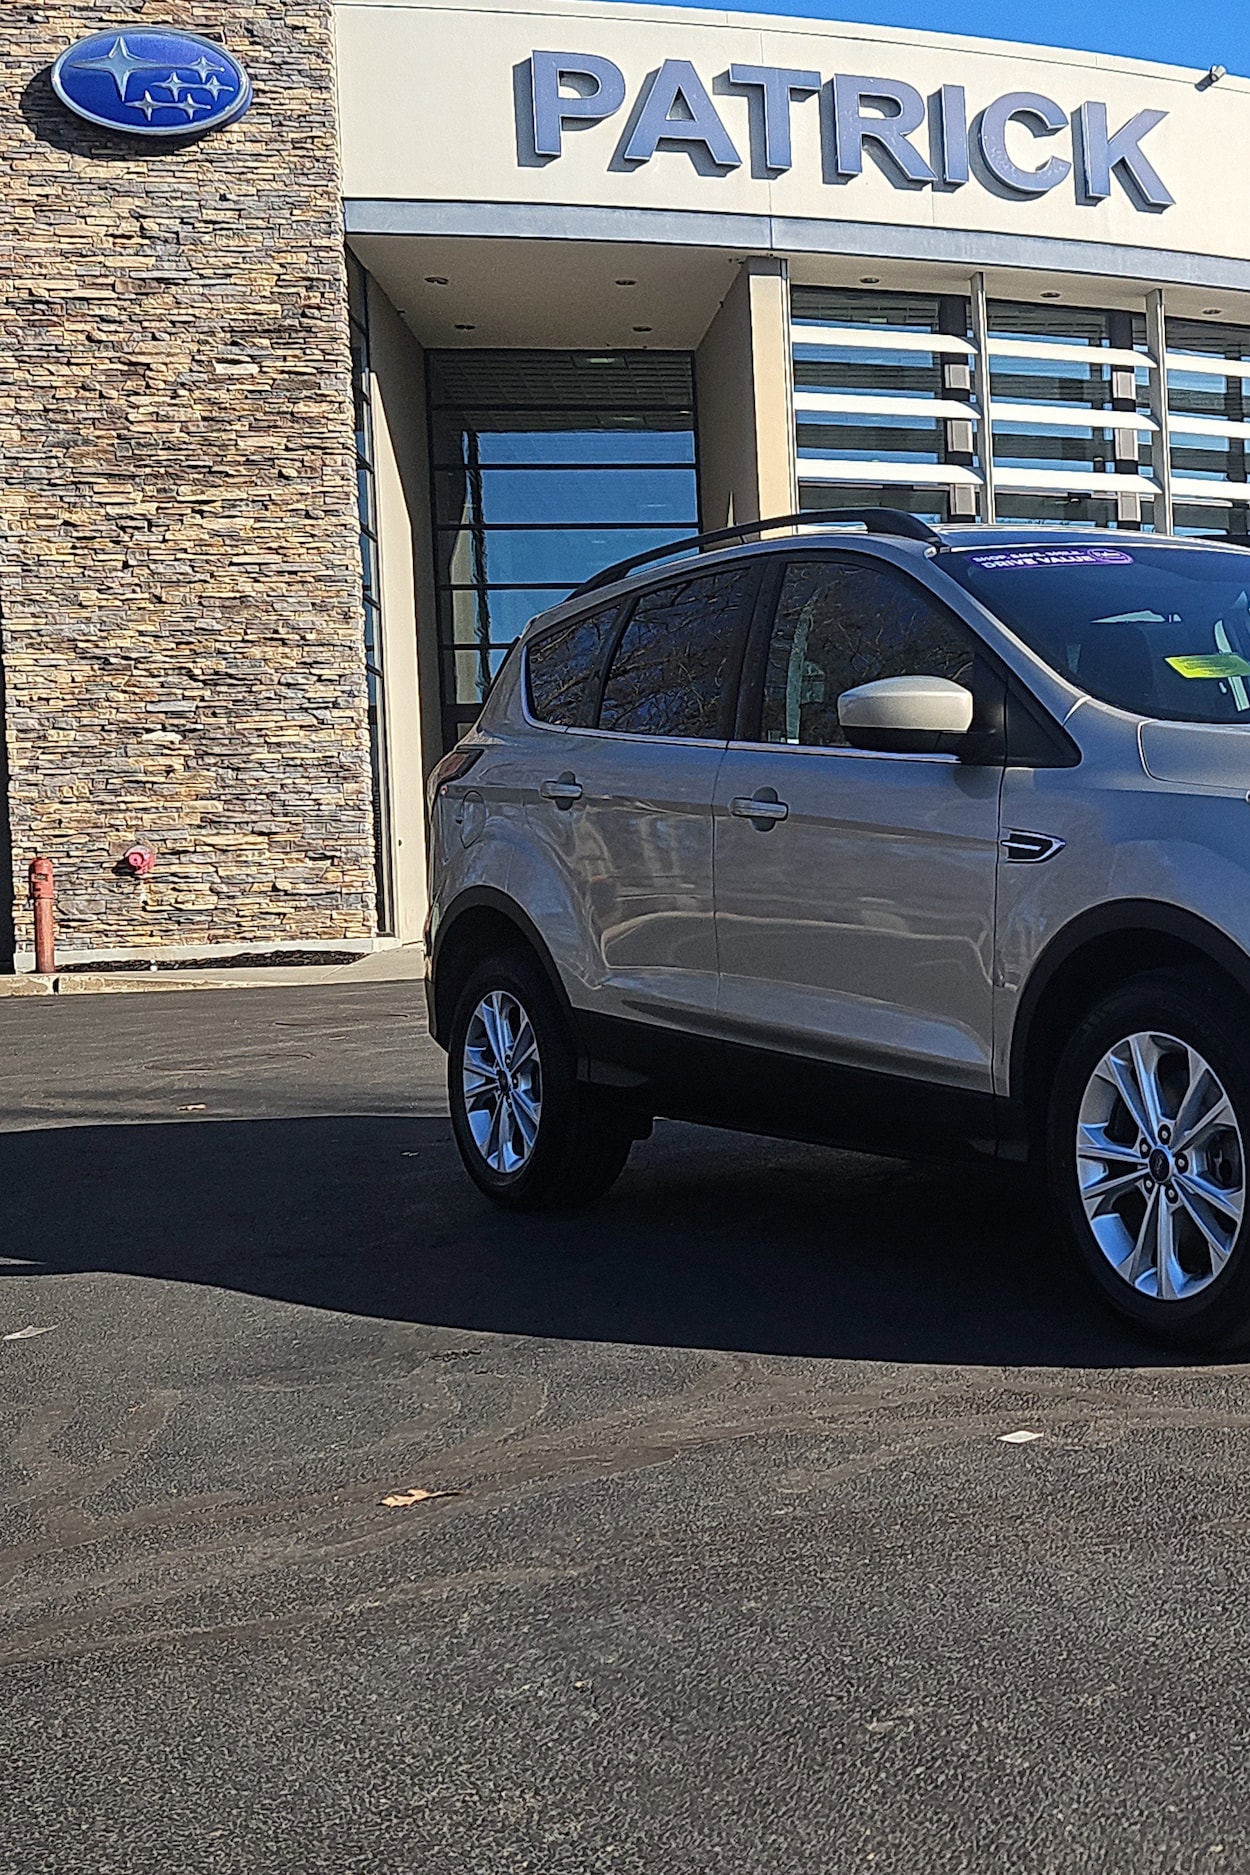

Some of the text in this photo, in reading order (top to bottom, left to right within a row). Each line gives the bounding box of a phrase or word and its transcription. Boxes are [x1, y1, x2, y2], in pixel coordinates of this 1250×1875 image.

[524, 49, 1176, 210] PATRICK
[981, 555, 1097, 569] DRIVE VALUE
